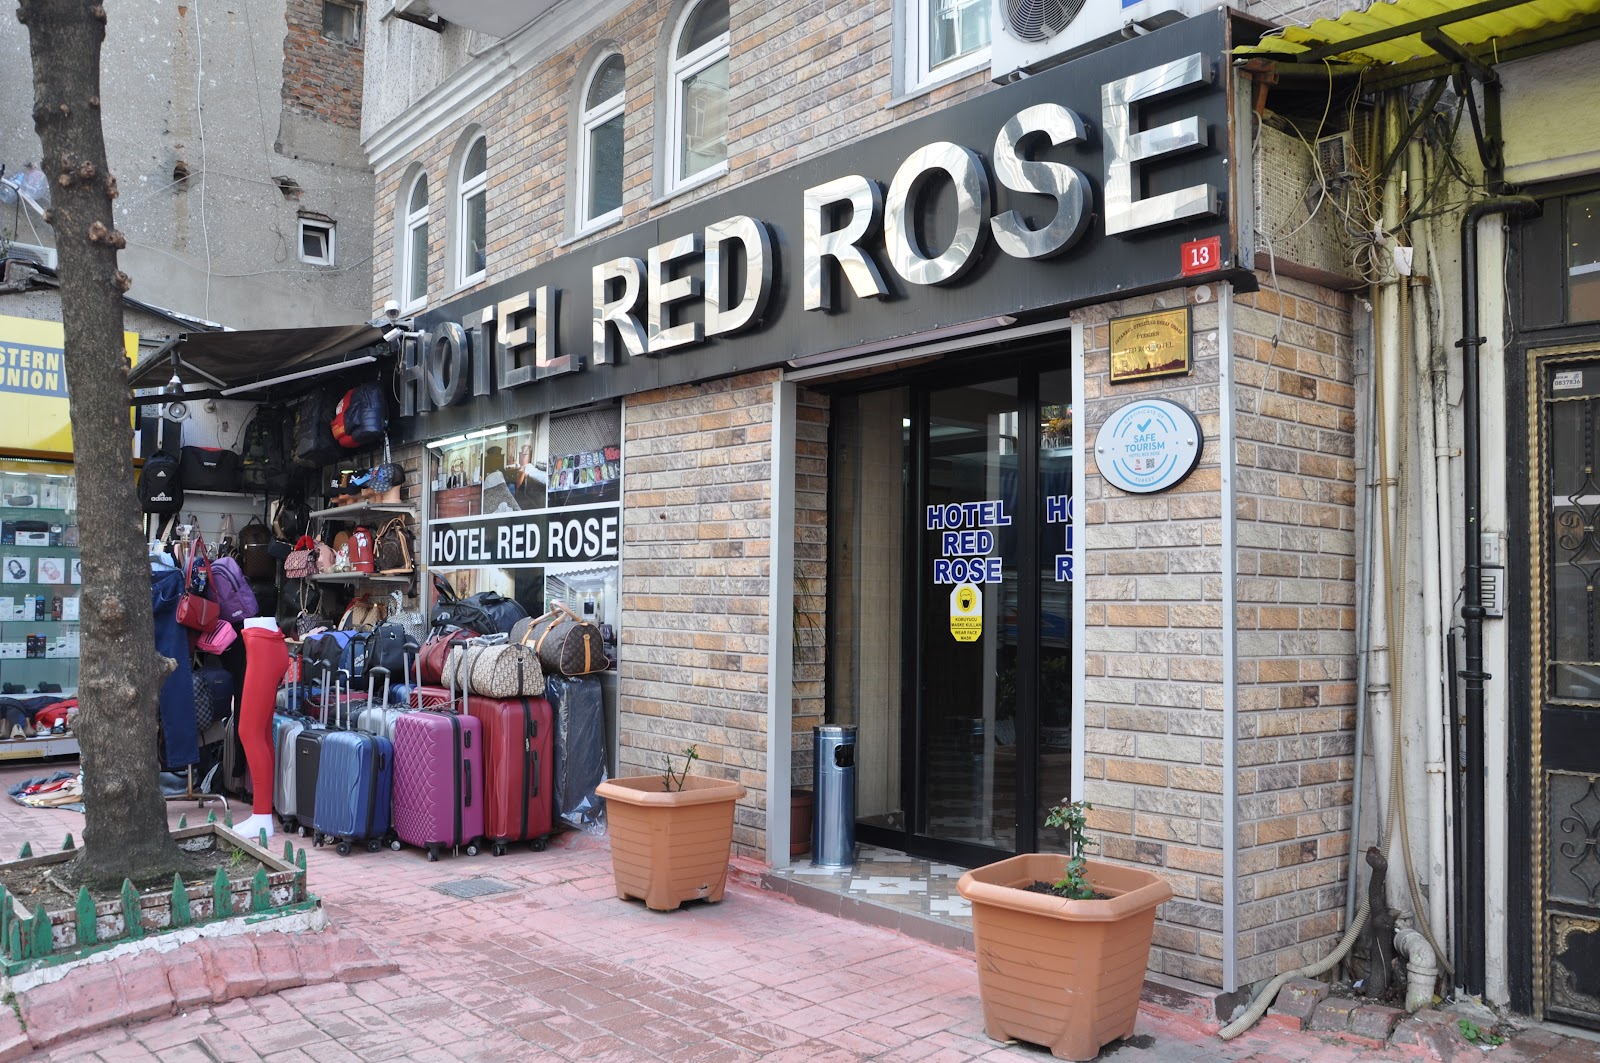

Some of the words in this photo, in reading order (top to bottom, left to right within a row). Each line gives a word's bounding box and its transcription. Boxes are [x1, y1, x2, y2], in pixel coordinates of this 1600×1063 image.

[400, 286, 580, 416] HOTEL
[592, 215, 772, 366] RED
[803, 52, 1217, 312] ROSE
[1191, 246, 1210, 267] 13
[1555, 378, 1580, 386] 0837836
[1125, 441, 1165, 453] TOURISM
[1133, 433, 1156, 443] SAFE
[927, 500, 1012, 530] HOTEL
[1046, 495, 1074, 523] H
[431, 527, 491, 562] HOTEL
[496, 523, 541, 559] RED
[547, 516, 618, 558] ROSE
[942, 529, 994, 557] RED
[934, 557, 1003, 584] ROSE
